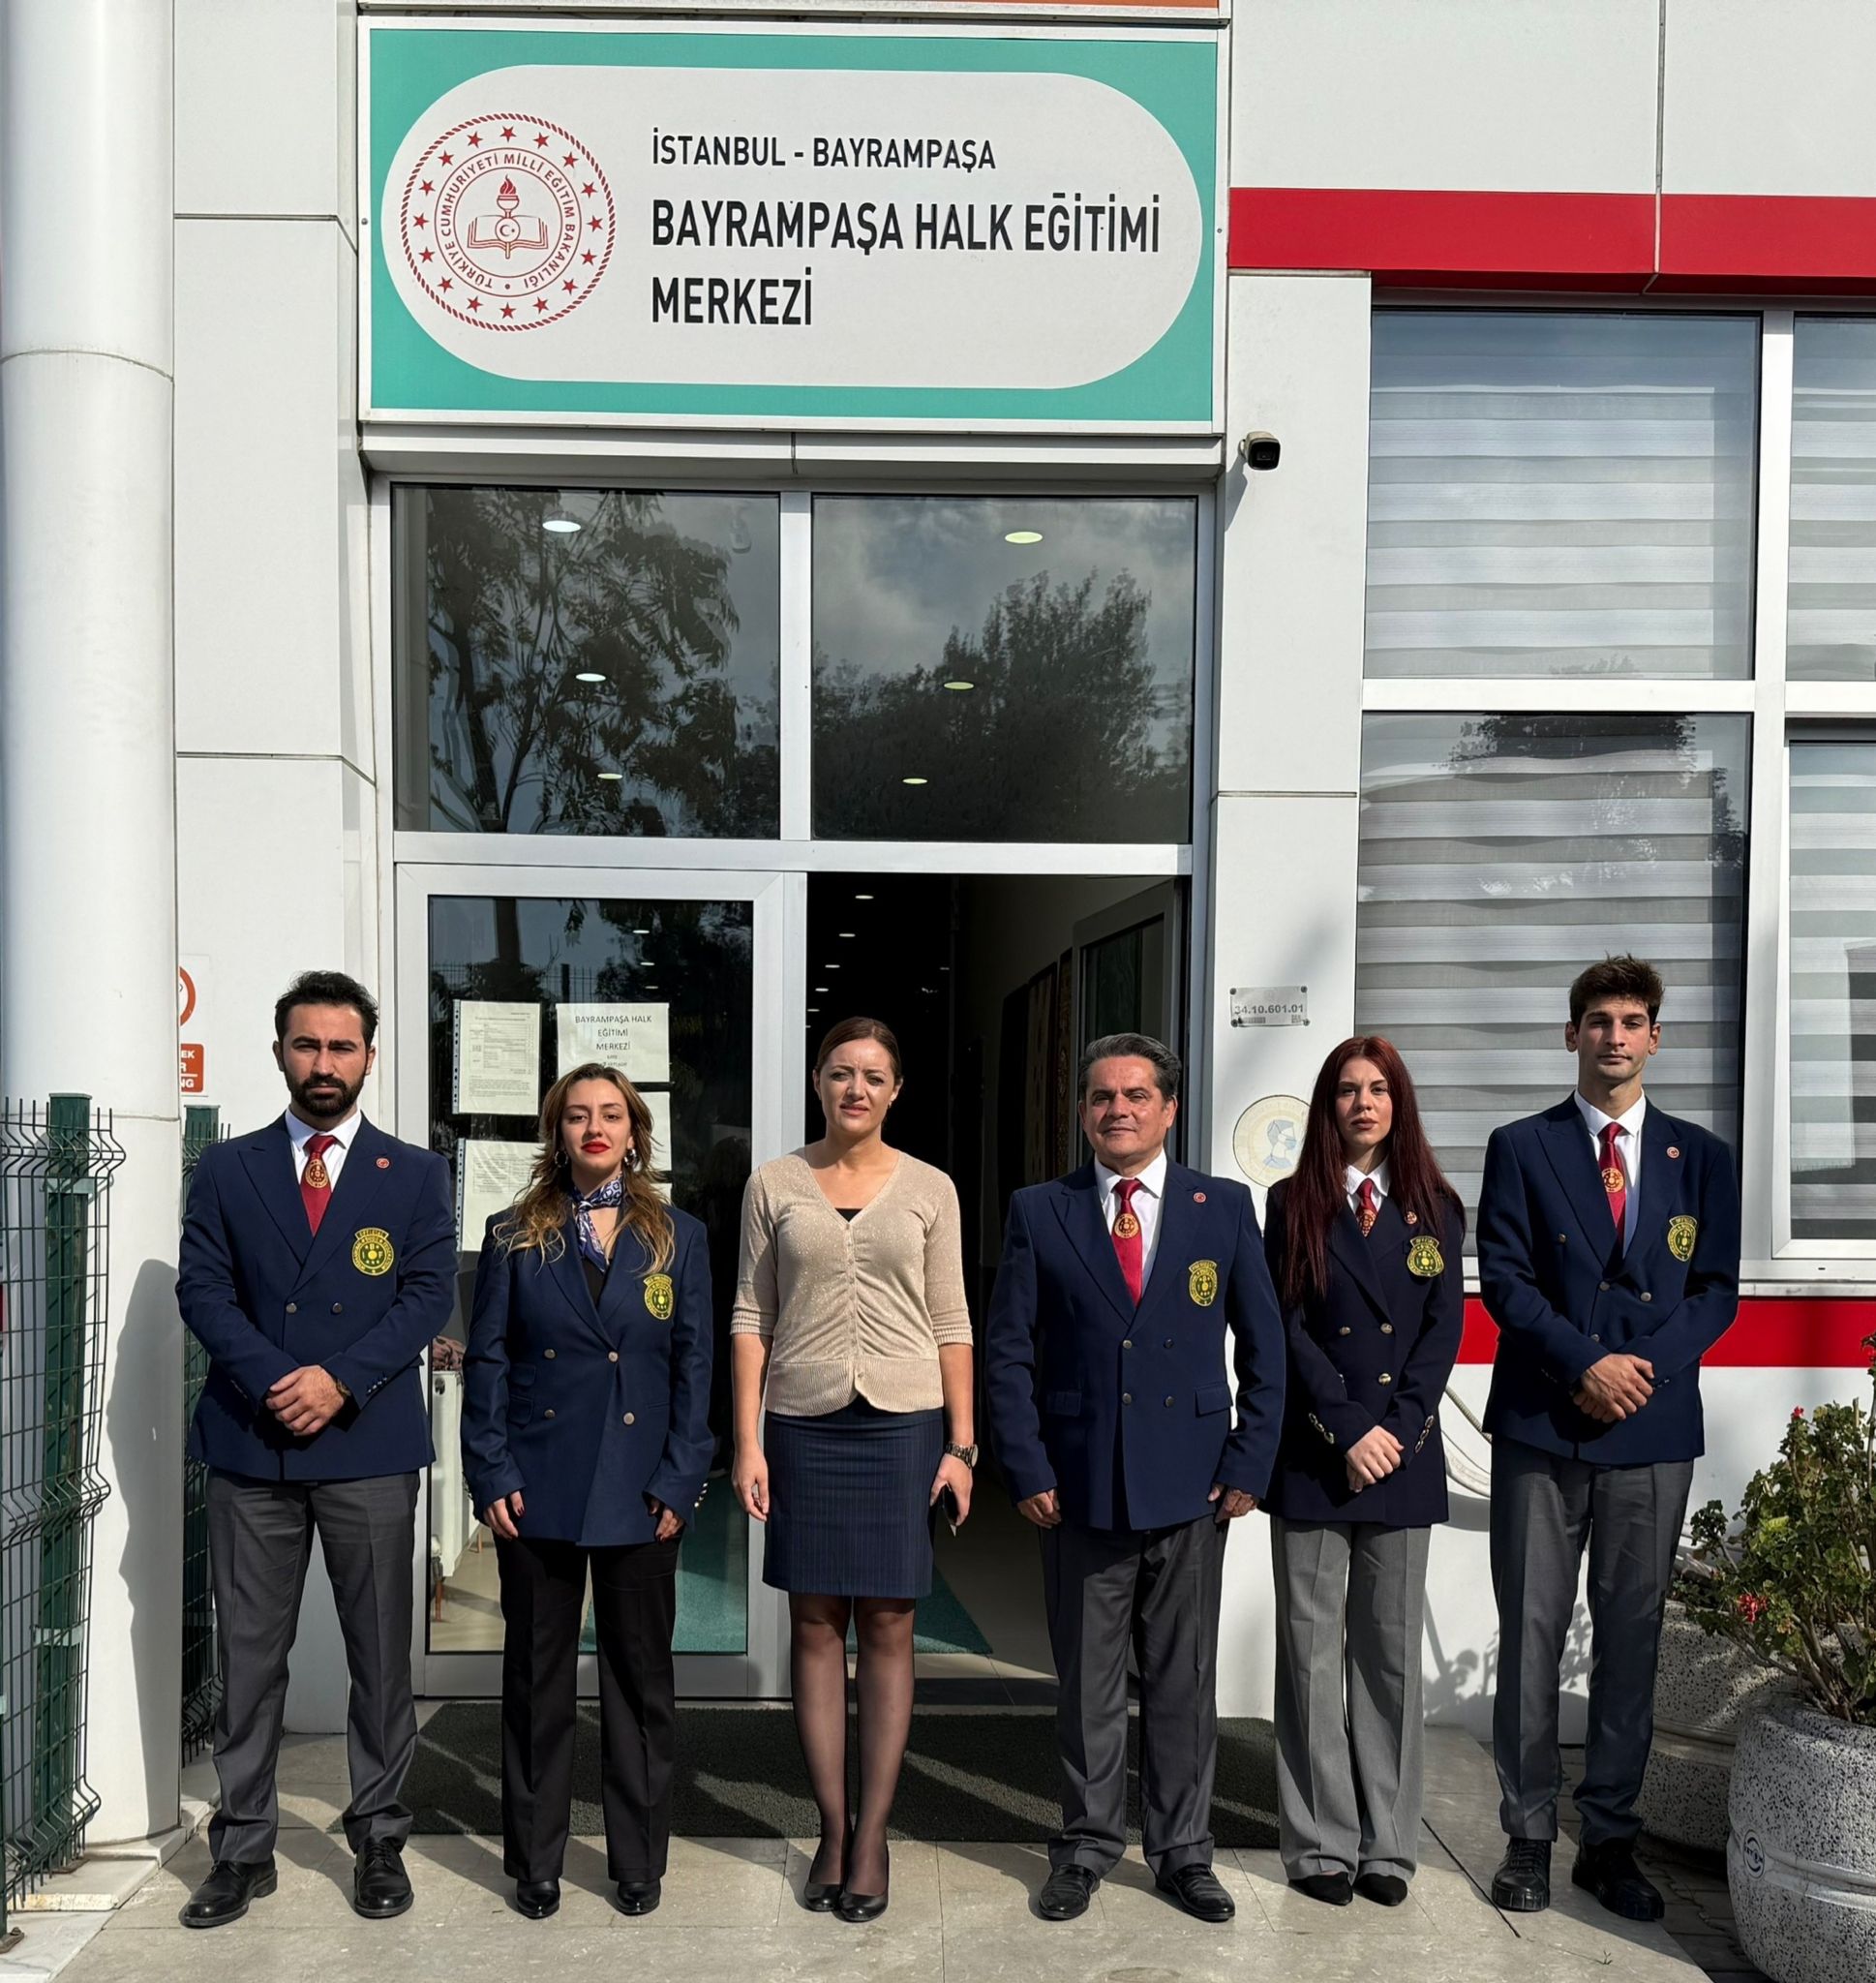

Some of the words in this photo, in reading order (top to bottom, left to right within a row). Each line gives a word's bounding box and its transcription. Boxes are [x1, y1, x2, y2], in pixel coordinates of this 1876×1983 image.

[652, 127, 786, 167] İSTANBUL
[813, 137, 996, 173] BAYRAMPAŞA
[440, 153, 499, 237] CUMHURİYETİ
[544, 169, 576, 218] EĞİTİM
[652, 198, 904, 256] BAYRAMPAŞA
[916, 203, 1014, 251] HALK
[1024, 192, 1160, 253] EĞİTİMİ
[444, 241, 493, 289] TÜRKİYE
[524, 223, 576, 289] BAKANLIĞI
[651, 266, 812, 325] MERKEZİ
[596, 1041, 630, 1050] MERKEZİ
[597, 1028, 628, 1037] EĞİTİMİ
